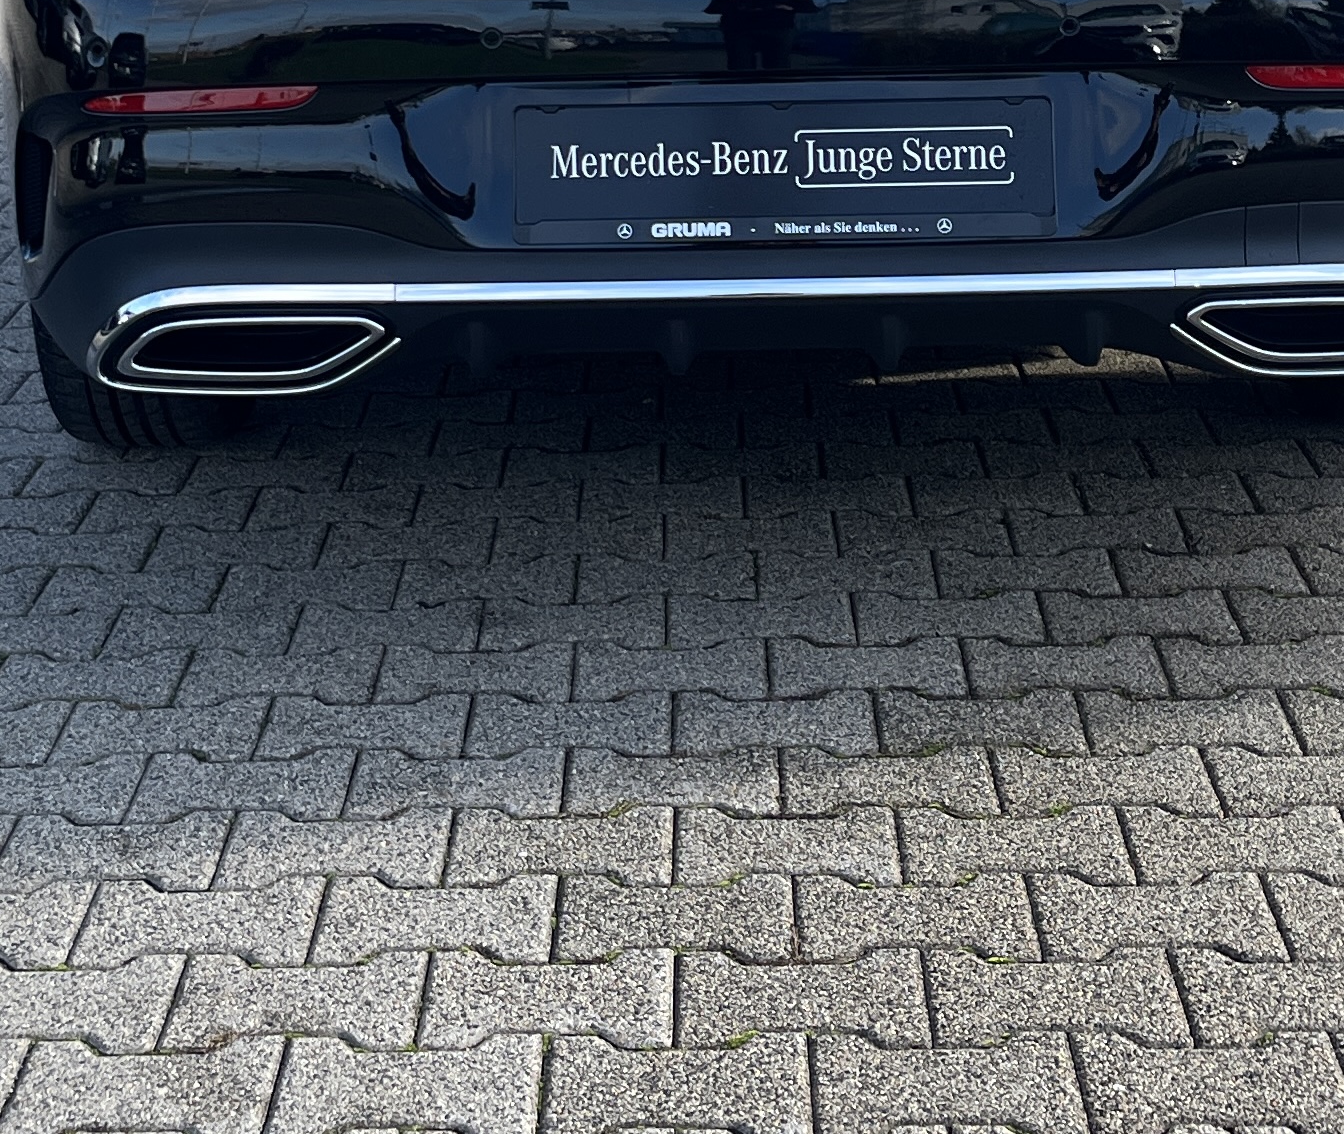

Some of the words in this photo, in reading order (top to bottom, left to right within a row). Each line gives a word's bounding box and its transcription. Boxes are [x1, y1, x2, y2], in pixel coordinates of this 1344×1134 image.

[550, 140, 789, 180] Mercedes-Benz
[803, 139, 894, 181] Junge
[902, 137, 1007, 173] Sterne
[651, 221, 732, 238] GRUMA
[774, 222, 812, 235] Näher
[814, 222, 831, 234] als
[833, 221, 852, 233] Sie
